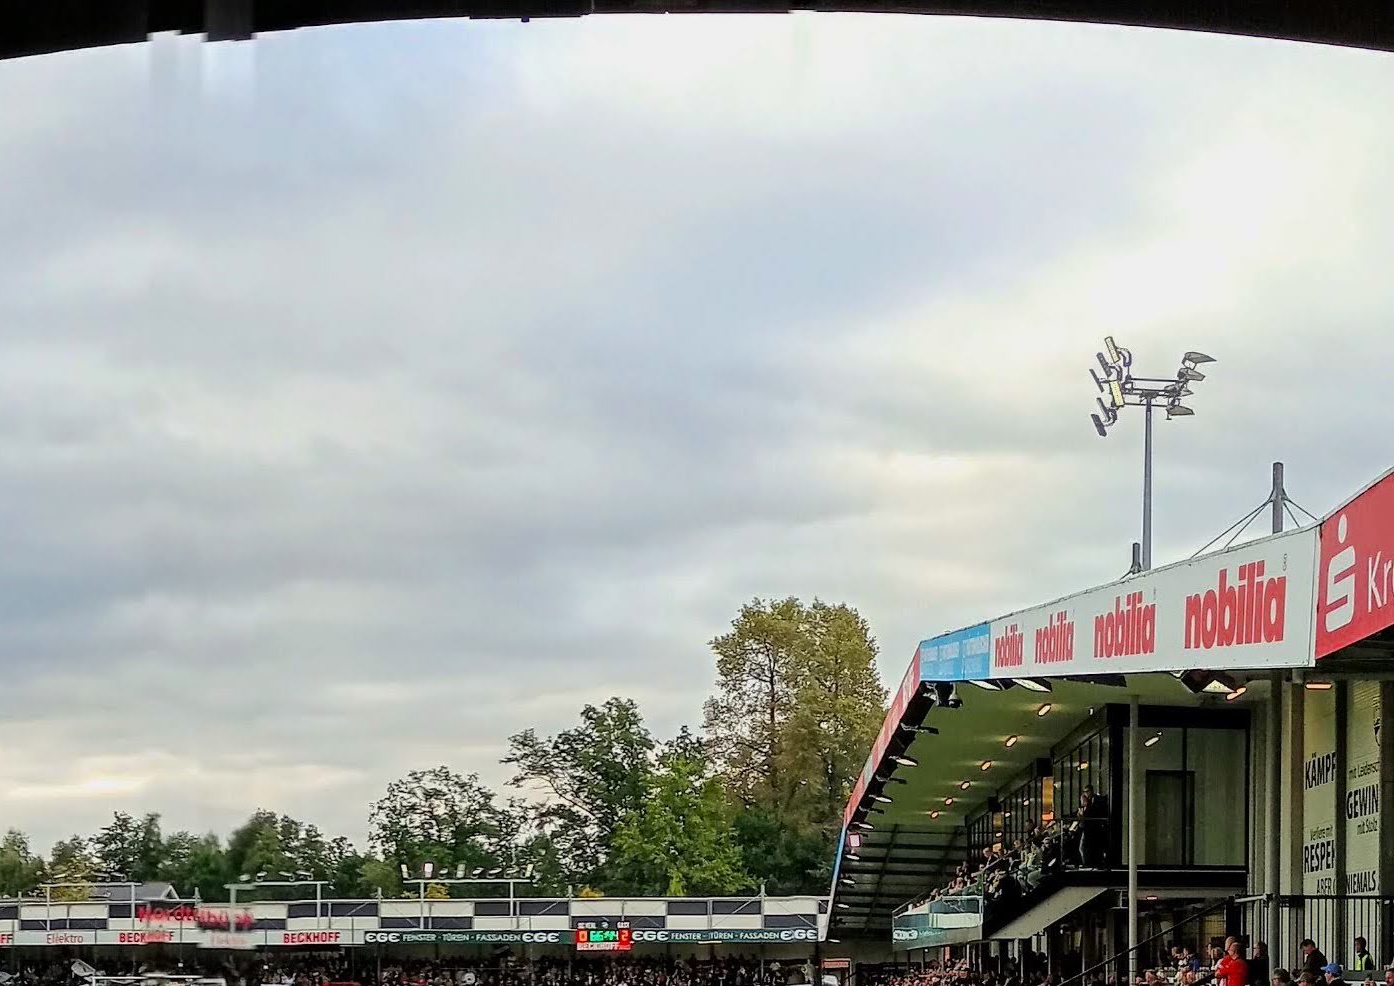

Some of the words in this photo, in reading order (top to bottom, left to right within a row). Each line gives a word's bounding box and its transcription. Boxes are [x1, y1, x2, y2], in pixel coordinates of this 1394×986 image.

[1368, 550, 1394, 613] Kr
[1093, 591, 1156, 658] nobilia
[1184, 560, 1286, 650] nobilia
[995, 624, 1024, 668] nobilia
[1035, 610, 1075, 665] nobilia
[1305, 752, 1337, 790] KÄMPF
[1346, 784, 1379, 820] GEWIN
[283, 931, 341, 943] BECKHOFF
[365, 931, 400, 943] EGE
[402, 933, 437, 942] FENSTER
[475, 933, 521, 942] FASSADEN
[631, 931, 669, 942] EGE
[671, 932, 702, 941] FENSTER
[739, 932, 780, 940] FASSADEN
